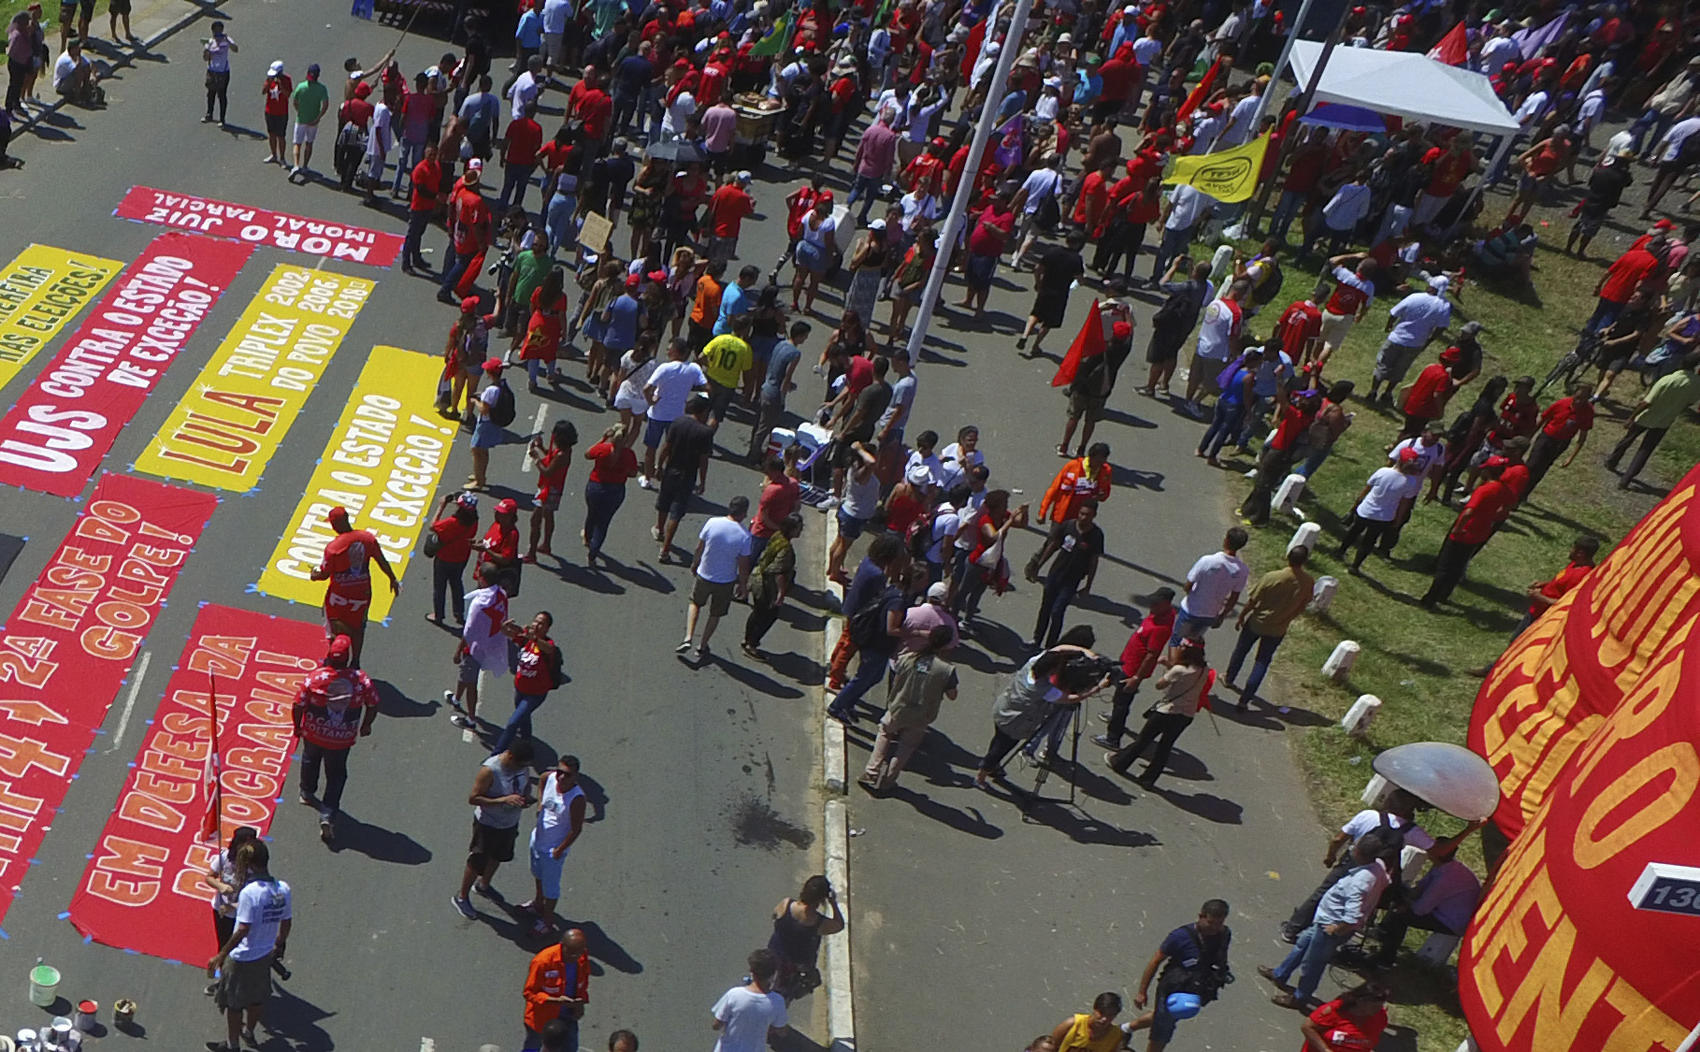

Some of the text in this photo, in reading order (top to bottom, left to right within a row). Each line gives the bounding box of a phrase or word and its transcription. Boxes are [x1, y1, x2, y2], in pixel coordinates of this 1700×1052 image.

[144, 206, 371, 263] MORO JUIZ
[154, 192, 376, 244] IMORAL PARCIAL
[40, 255, 195, 399] CONTRA O ESTADO
[217, 271, 312, 380] TRIPLEX 2002
[270, 278, 341, 392] DO POVO 2006
[326, 287, 369, 320] 2018
[106, 360, 159, 389] DE
[718, 347, 738, 372] 10
[157, 387, 288, 477] LULA
[331, 394, 402, 468] ESTADO
[330, 470, 374, 487] O
[18, 546, 113, 632] FASE
[75, 500, 141, 545] DO
[328, 592, 368, 612] PT
[85, 634, 258, 907] EM DEFESA DA
